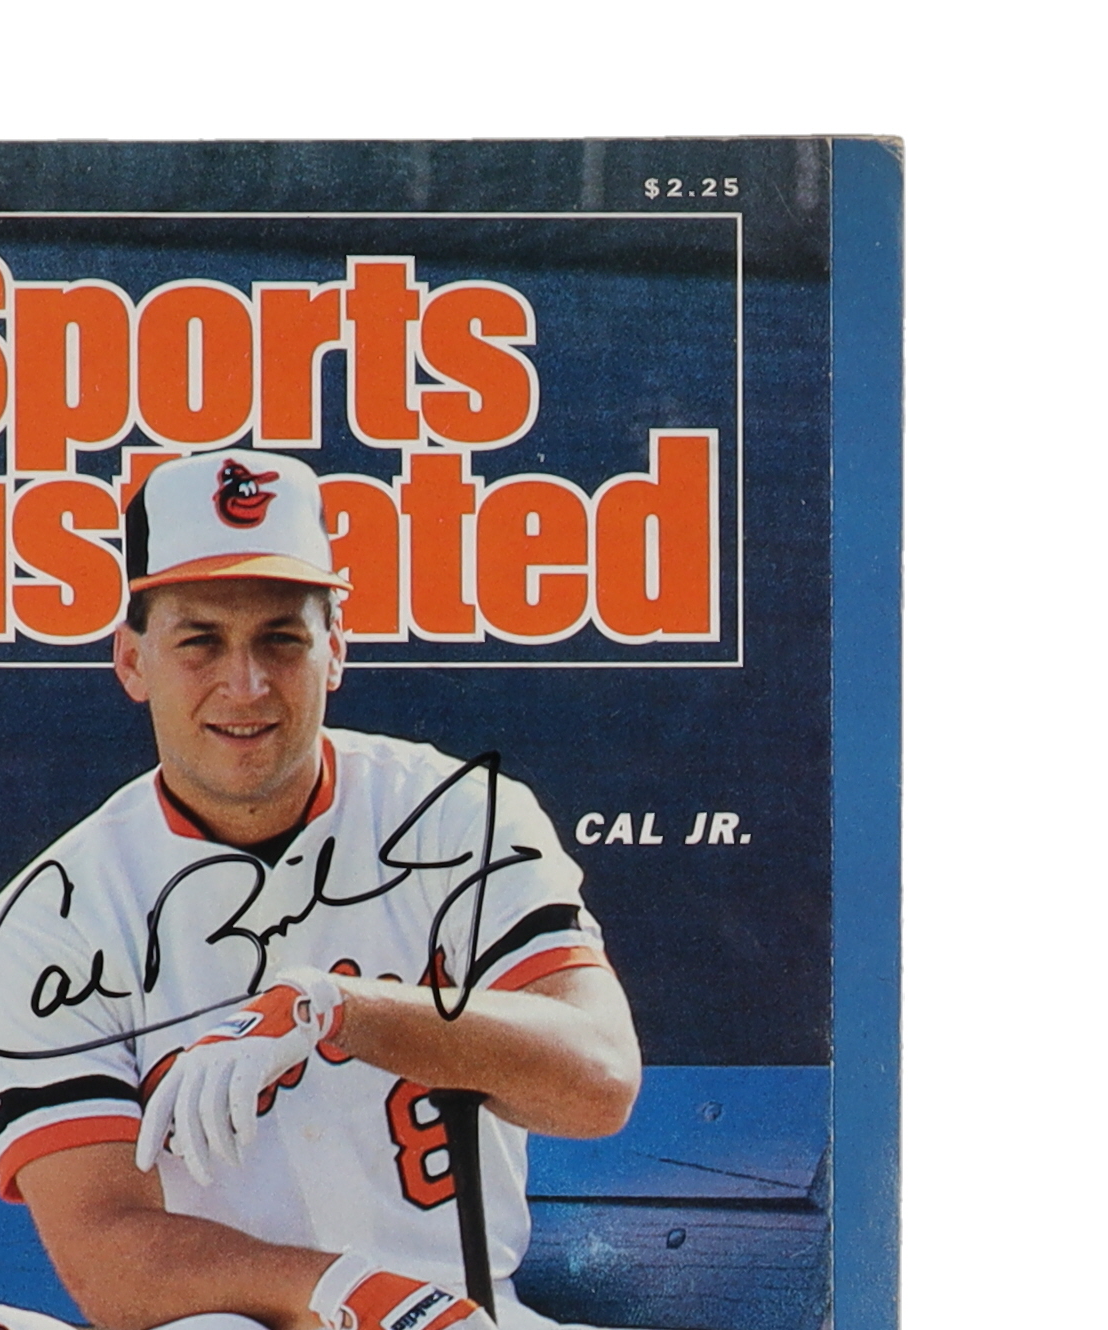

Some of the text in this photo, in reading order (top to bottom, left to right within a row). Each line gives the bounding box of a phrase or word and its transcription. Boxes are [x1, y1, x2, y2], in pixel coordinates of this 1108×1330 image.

[643, 176, 740, 200] $2.25
[574, 811, 752, 846] CAL JR.
